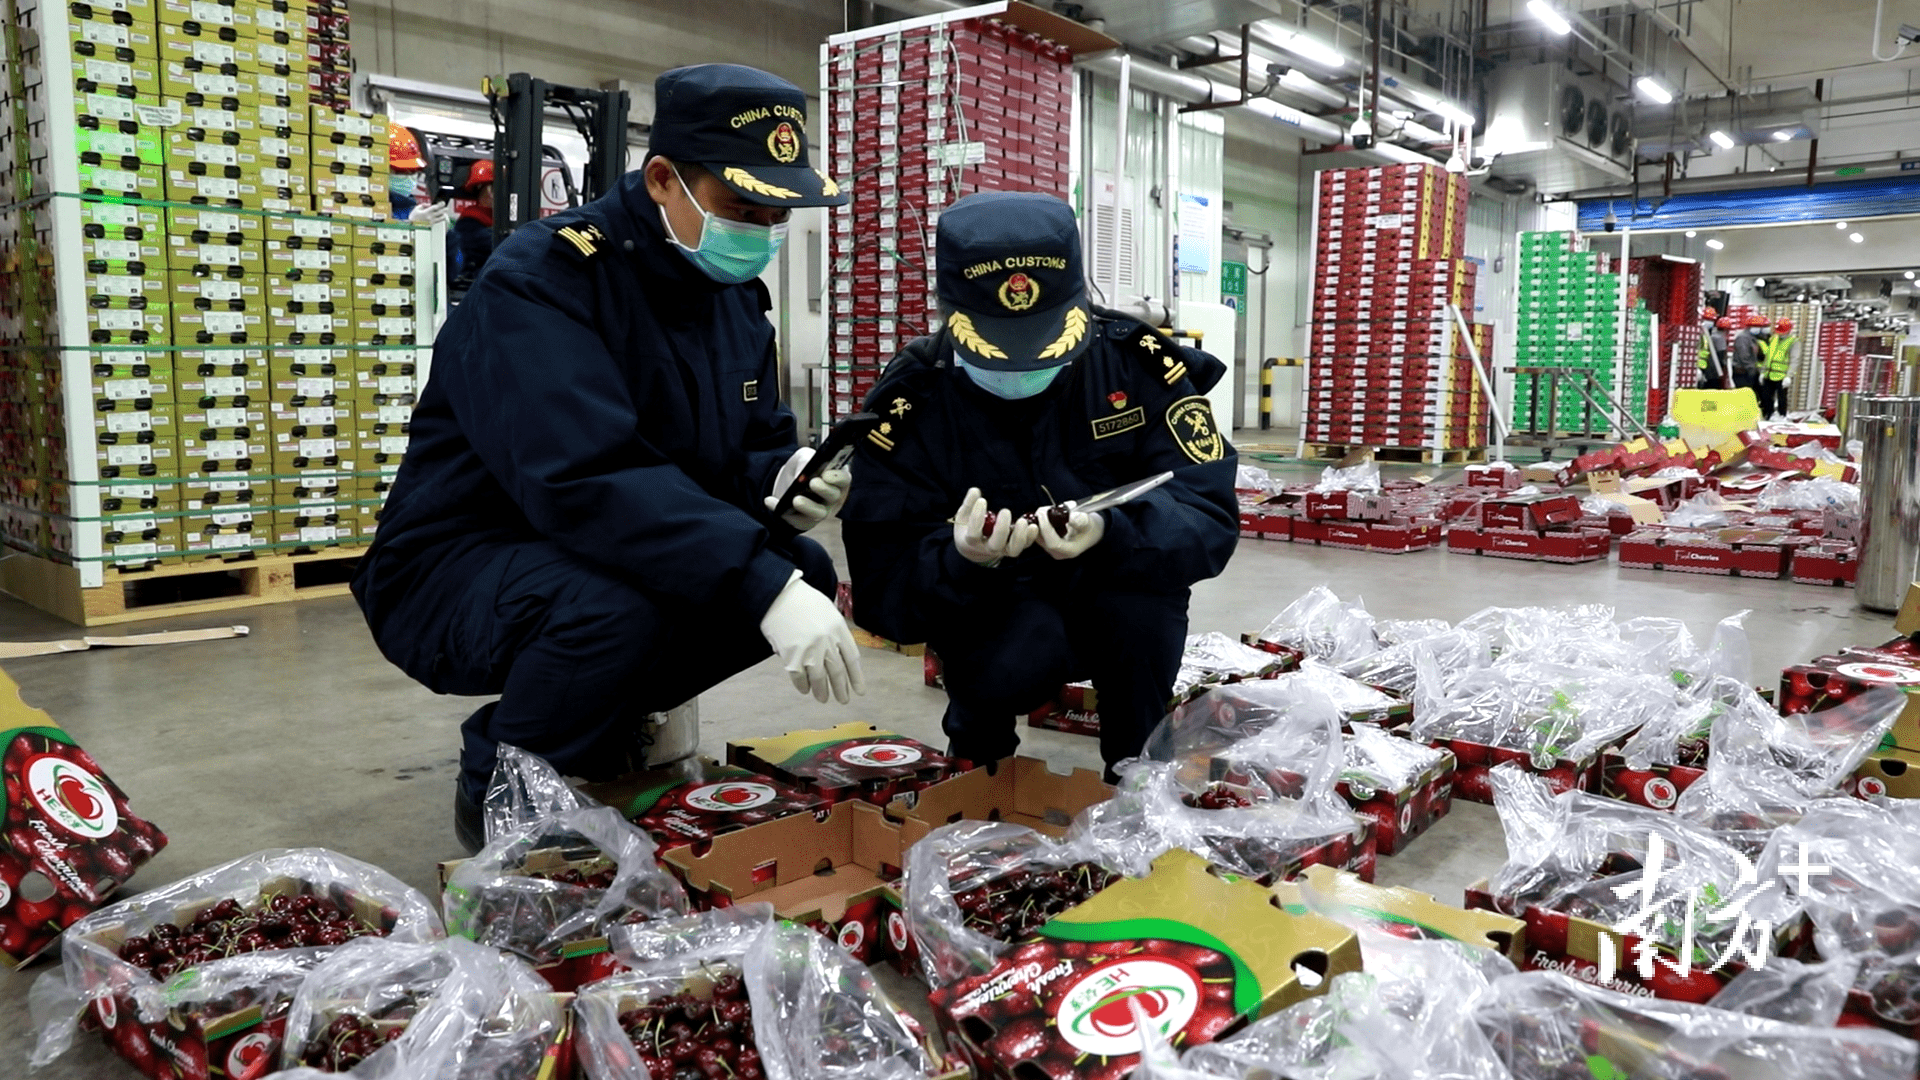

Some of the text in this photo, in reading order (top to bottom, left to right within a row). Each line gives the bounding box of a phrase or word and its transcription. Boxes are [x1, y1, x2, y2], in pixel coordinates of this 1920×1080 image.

[730, 107, 770, 129] CHINA
[963, 256, 1066, 279] CHINA CUSTOMS
[1172, 407, 1185, 425] CHINA
[28, 818, 69, 852] Fresh
[34, 838, 86, 892] Cherries
[970, 962, 1042, 1008] Cherries
[1027, 960, 1074, 994] Fresh
[1531, 950, 1656, 1000] Fresh Cerries
